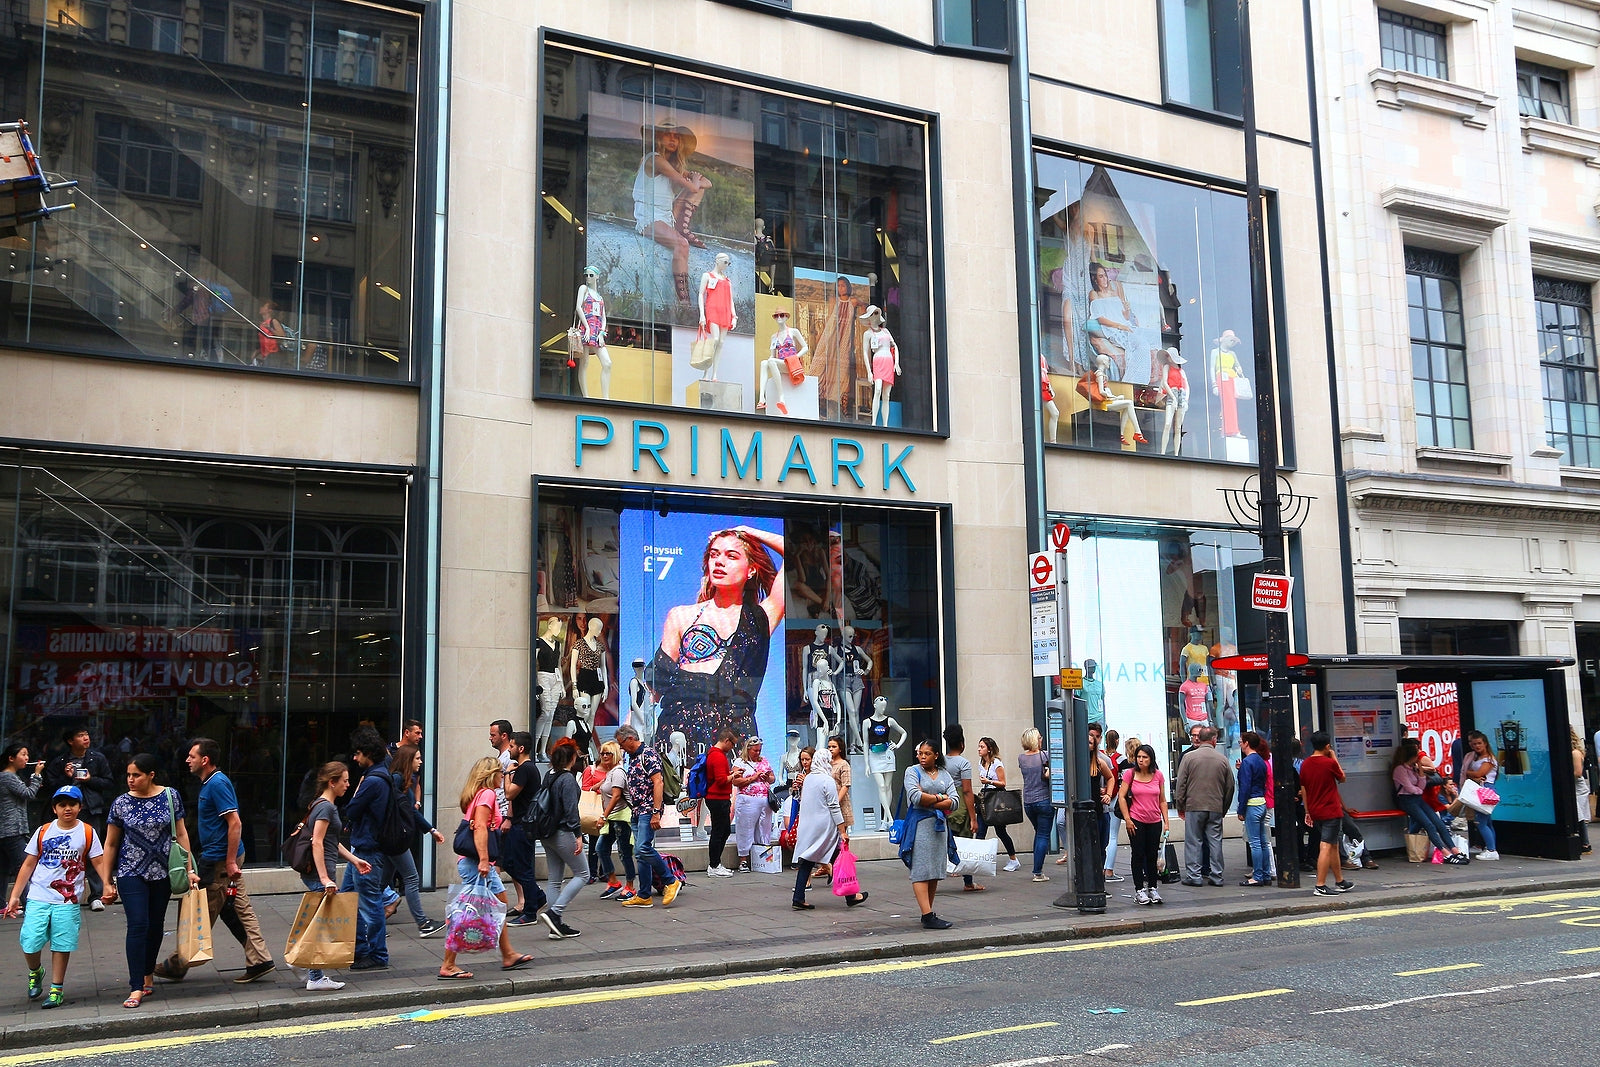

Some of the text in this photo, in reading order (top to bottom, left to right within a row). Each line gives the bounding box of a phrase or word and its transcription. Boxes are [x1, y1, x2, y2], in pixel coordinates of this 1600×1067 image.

[575, 414, 917, 492] PRIMARK
[1053, 527, 1065, 545] V
[643, 545, 683, 556] Playsuit
[643, 555, 675, 581] £7
[1255, 587, 1283, 597] PRIORITIES
[1258, 580, 1278, 588] SIGNAL
[1255, 597, 1281, 606] CHANGED
[1405, 691, 1458, 715] EDUCTIONS
[1406, 703, 1459, 727] EDUCTIONS
[1408, 728, 1458, 768] 0%
